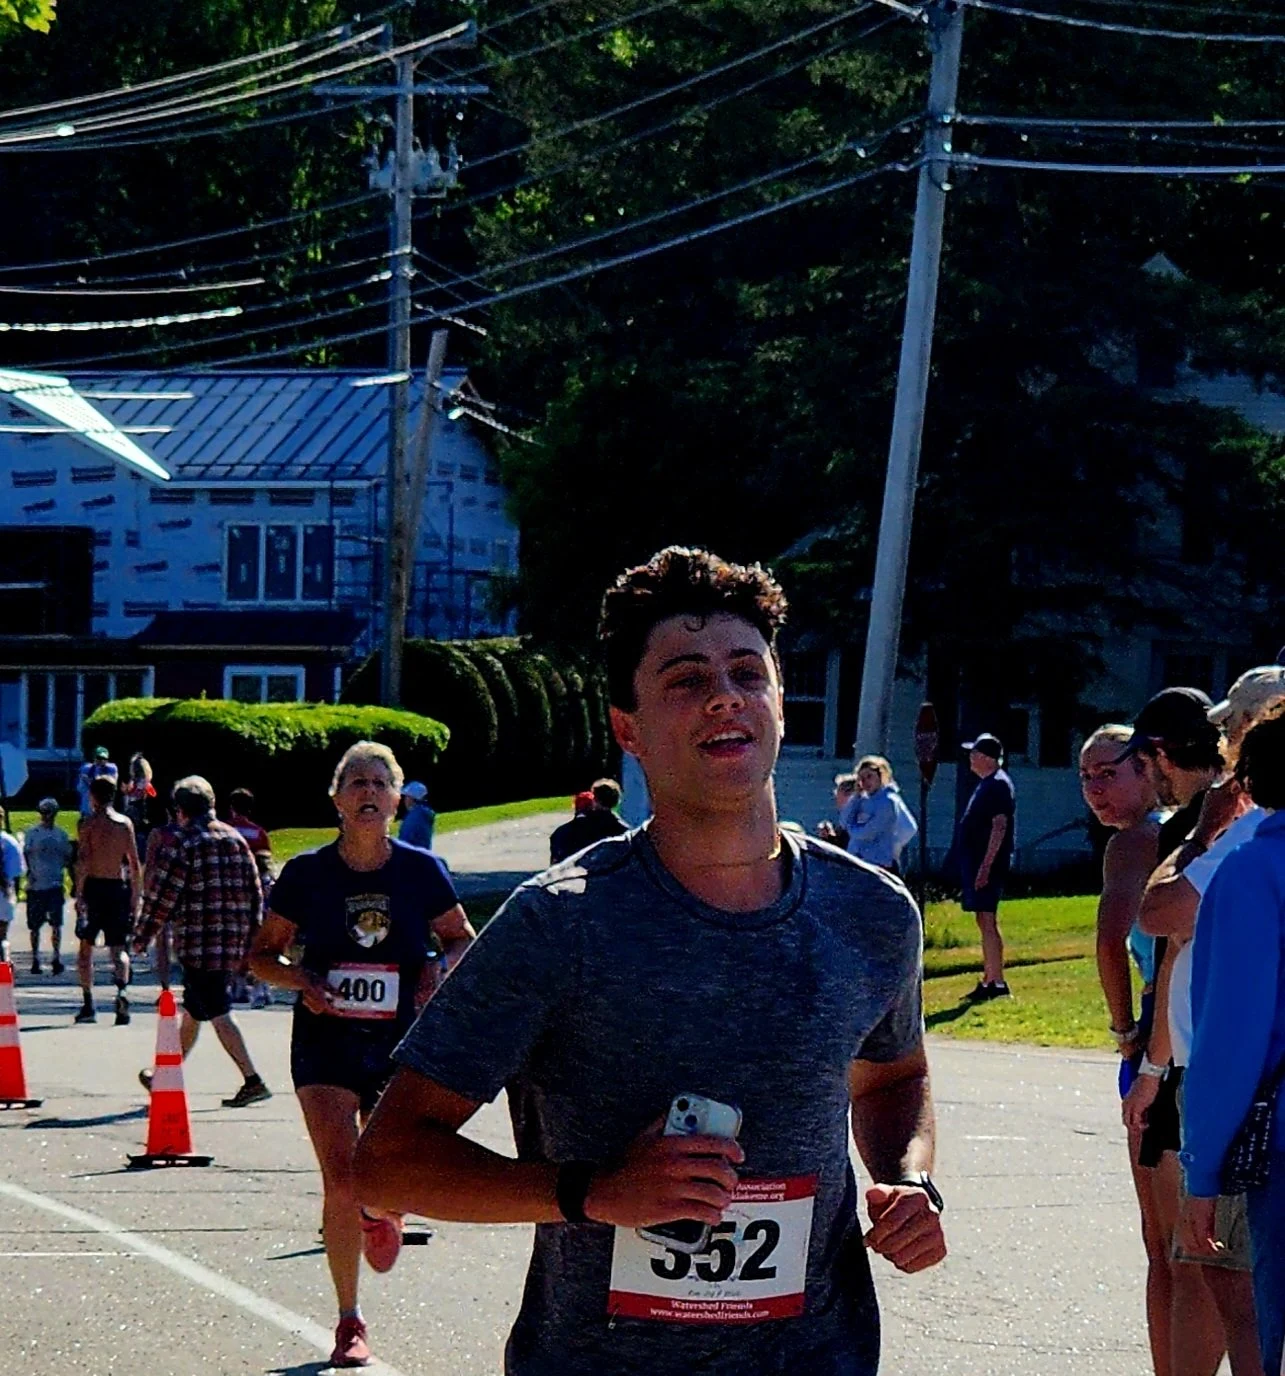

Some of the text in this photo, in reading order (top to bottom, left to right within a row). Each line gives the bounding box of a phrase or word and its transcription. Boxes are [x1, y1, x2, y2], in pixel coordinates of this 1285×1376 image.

[339, 978, 385, 1002] 400
[736, 1182, 787, 1191] Association
[650, 1219, 780, 1282] 352
[671, 1301, 753, 1310] Watershed Friends
[650, 1308, 769, 1319] www.watershedfriends.com
